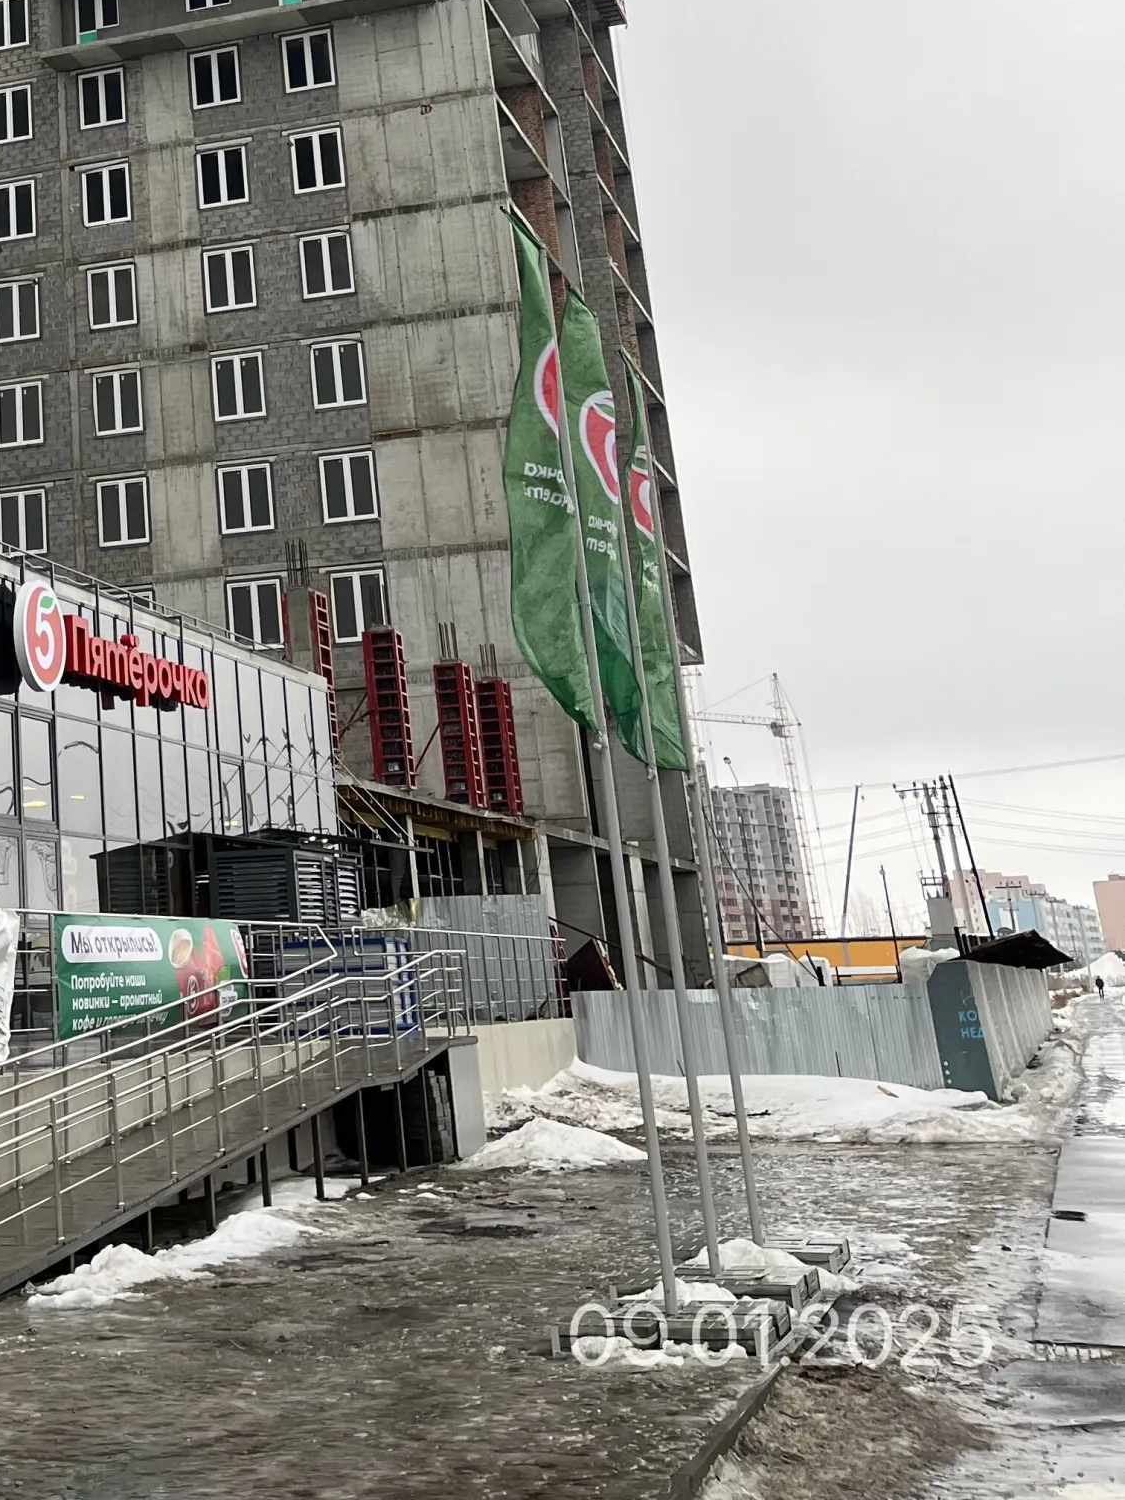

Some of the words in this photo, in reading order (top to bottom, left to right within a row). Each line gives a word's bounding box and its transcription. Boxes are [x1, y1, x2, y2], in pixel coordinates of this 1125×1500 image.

[65, 615, 210, 709] Пятёрочка
[70, 931, 93, 954] Мы
[94, 933, 158, 959] открылись!
[70, 972, 125, 993] Попробуйте
[125, 973, 147, 988] наши
[71, 995, 111, 1011] новинки
[119, 989, 164, 1011] ароматный
[71, 1013, 96, 1033] кофе
